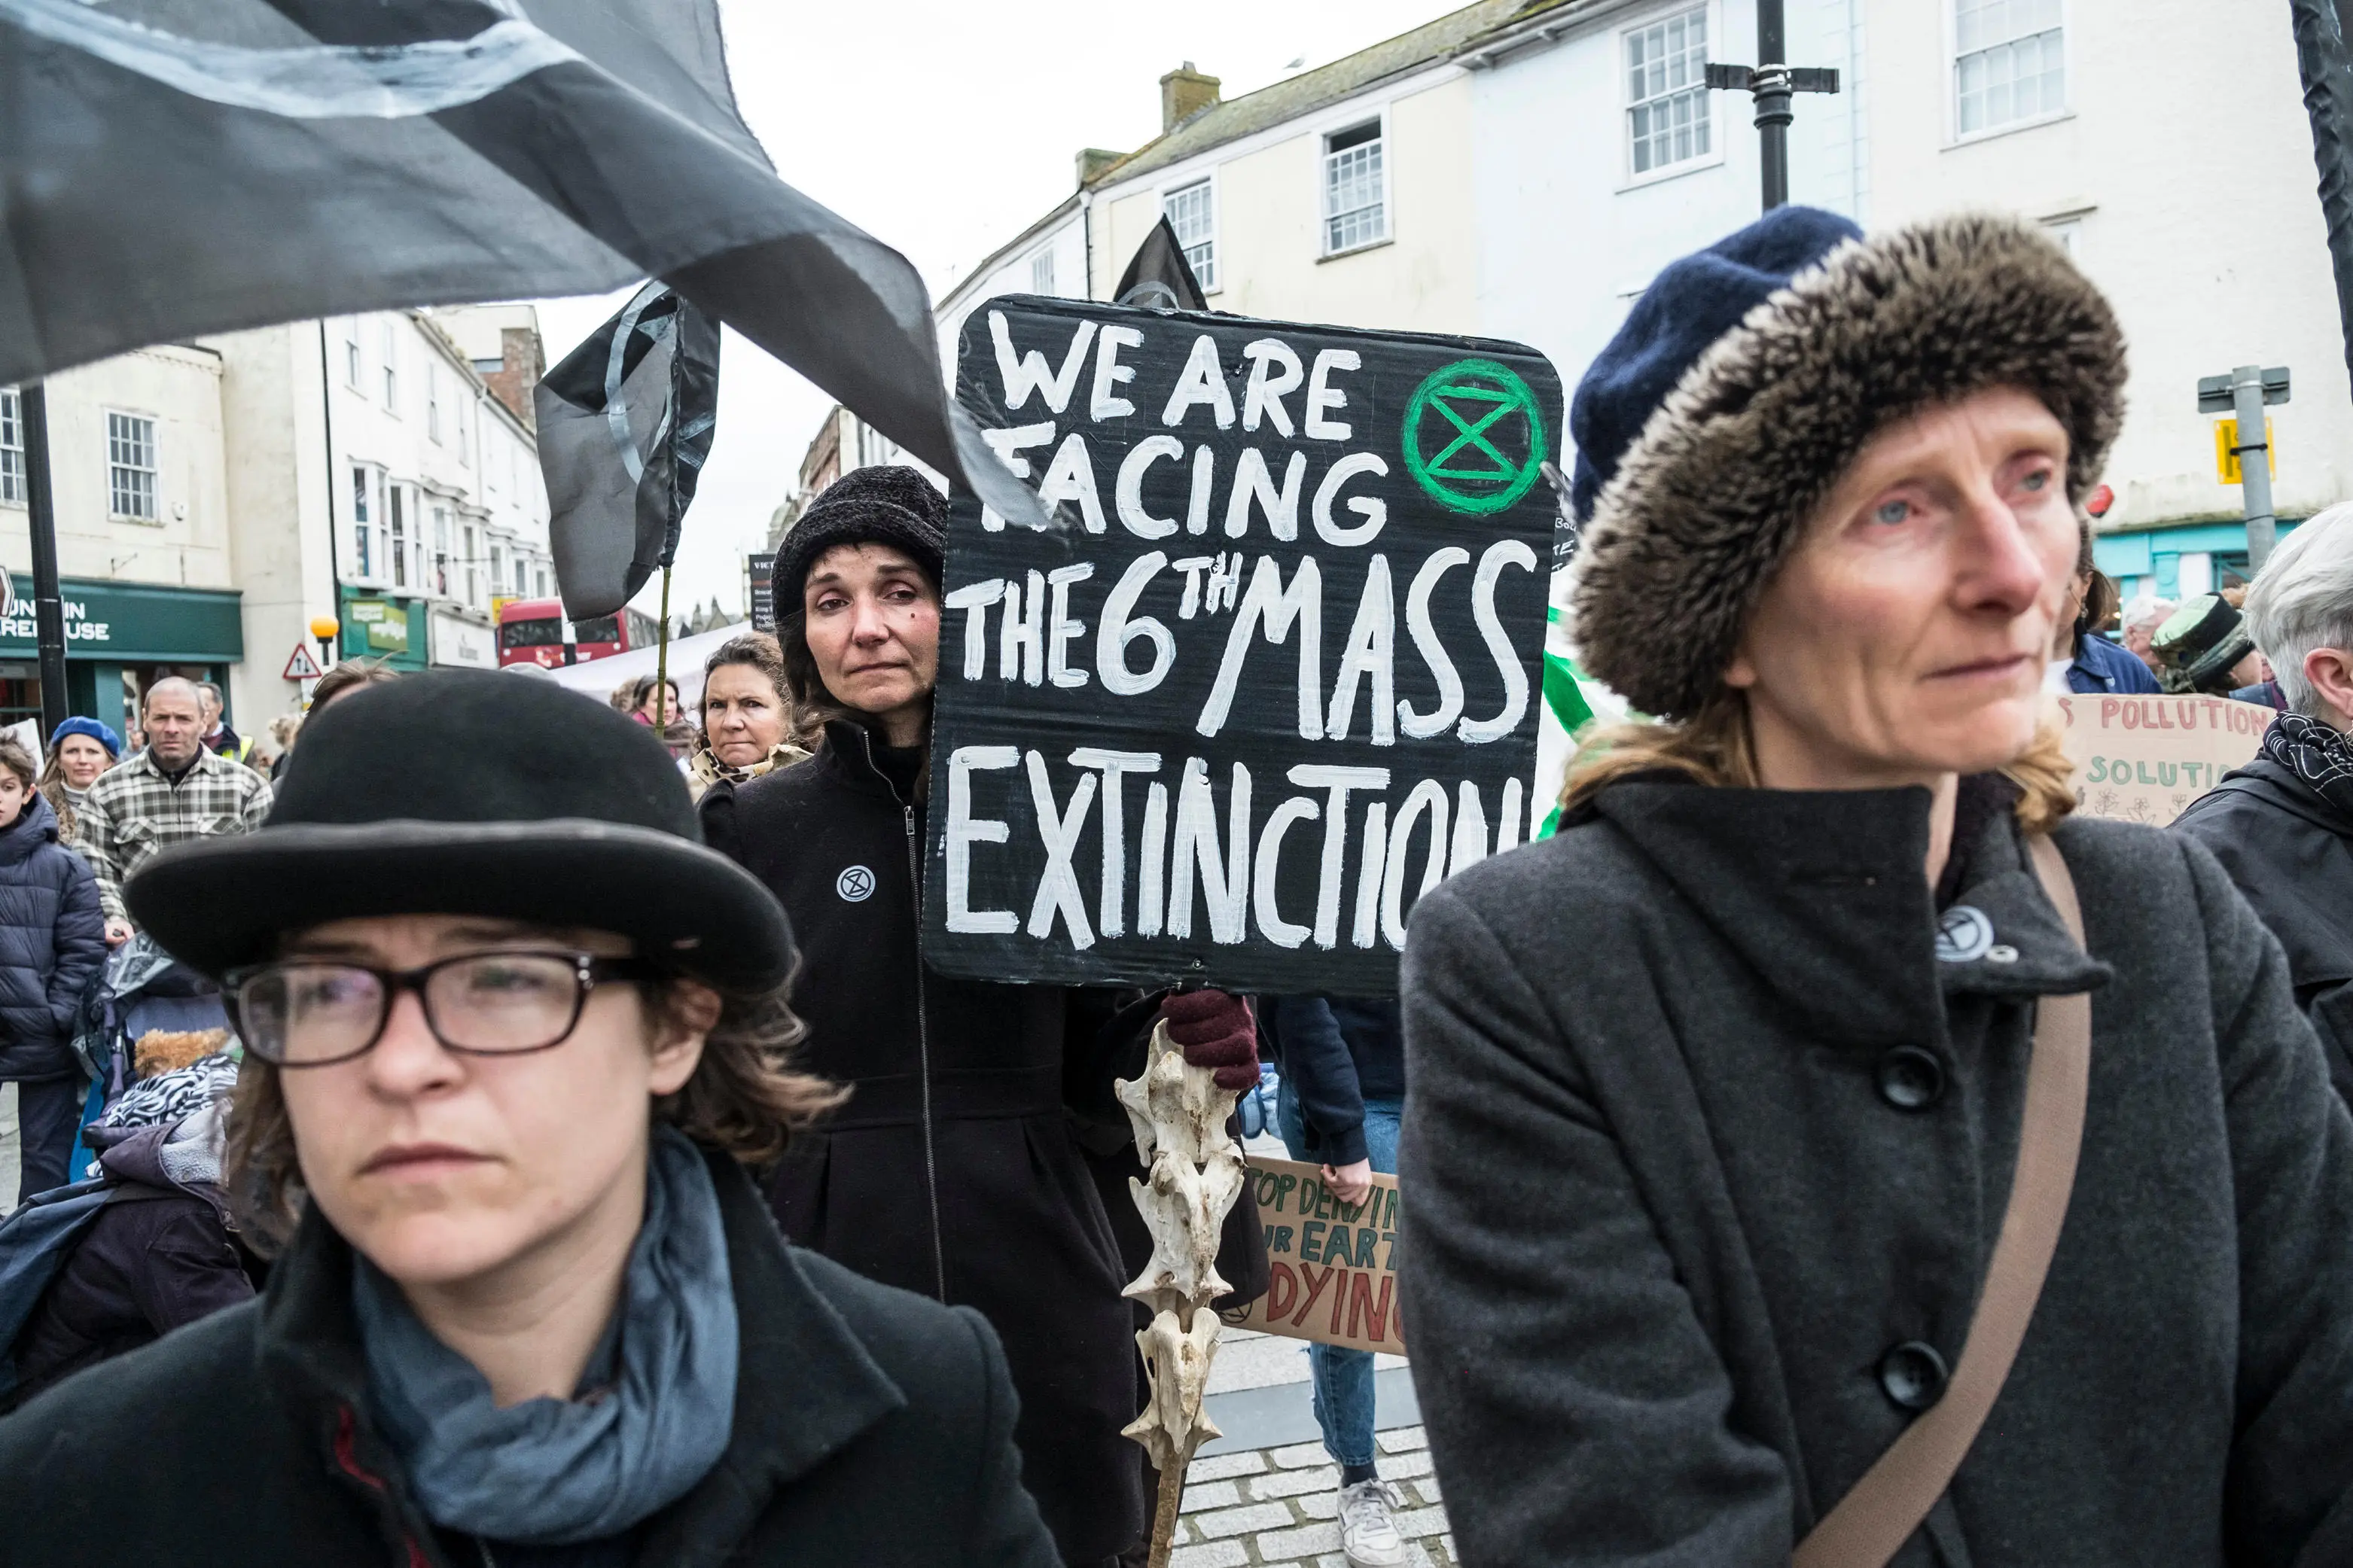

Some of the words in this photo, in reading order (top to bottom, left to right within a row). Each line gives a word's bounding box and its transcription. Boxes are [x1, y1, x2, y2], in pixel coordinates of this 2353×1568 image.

[987, 309, 1144, 420] WE
[1162, 334, 1361, 441] ARE
[980, 420, 1389, 547] FACING
[0, 619, 110, 641] REUSE
[9, 598, 86, 620] UNIN
[944, 562, 1096, 690] THE
[1096, 550, 1244, 697] 6TH
[1196, 539, 1537, 746] MASS
[2101, 698, 2269, 736] POLLUTION
[2086, 755, 2231, 789] SOLUTI
[1248, 1168, 1297, 1212] TOP
[1299, 1177, 1400, 1232] DENYIN
[1265, 1225, 1294, 1253] UR
[1300, 1220, 1399, 1271] EART
